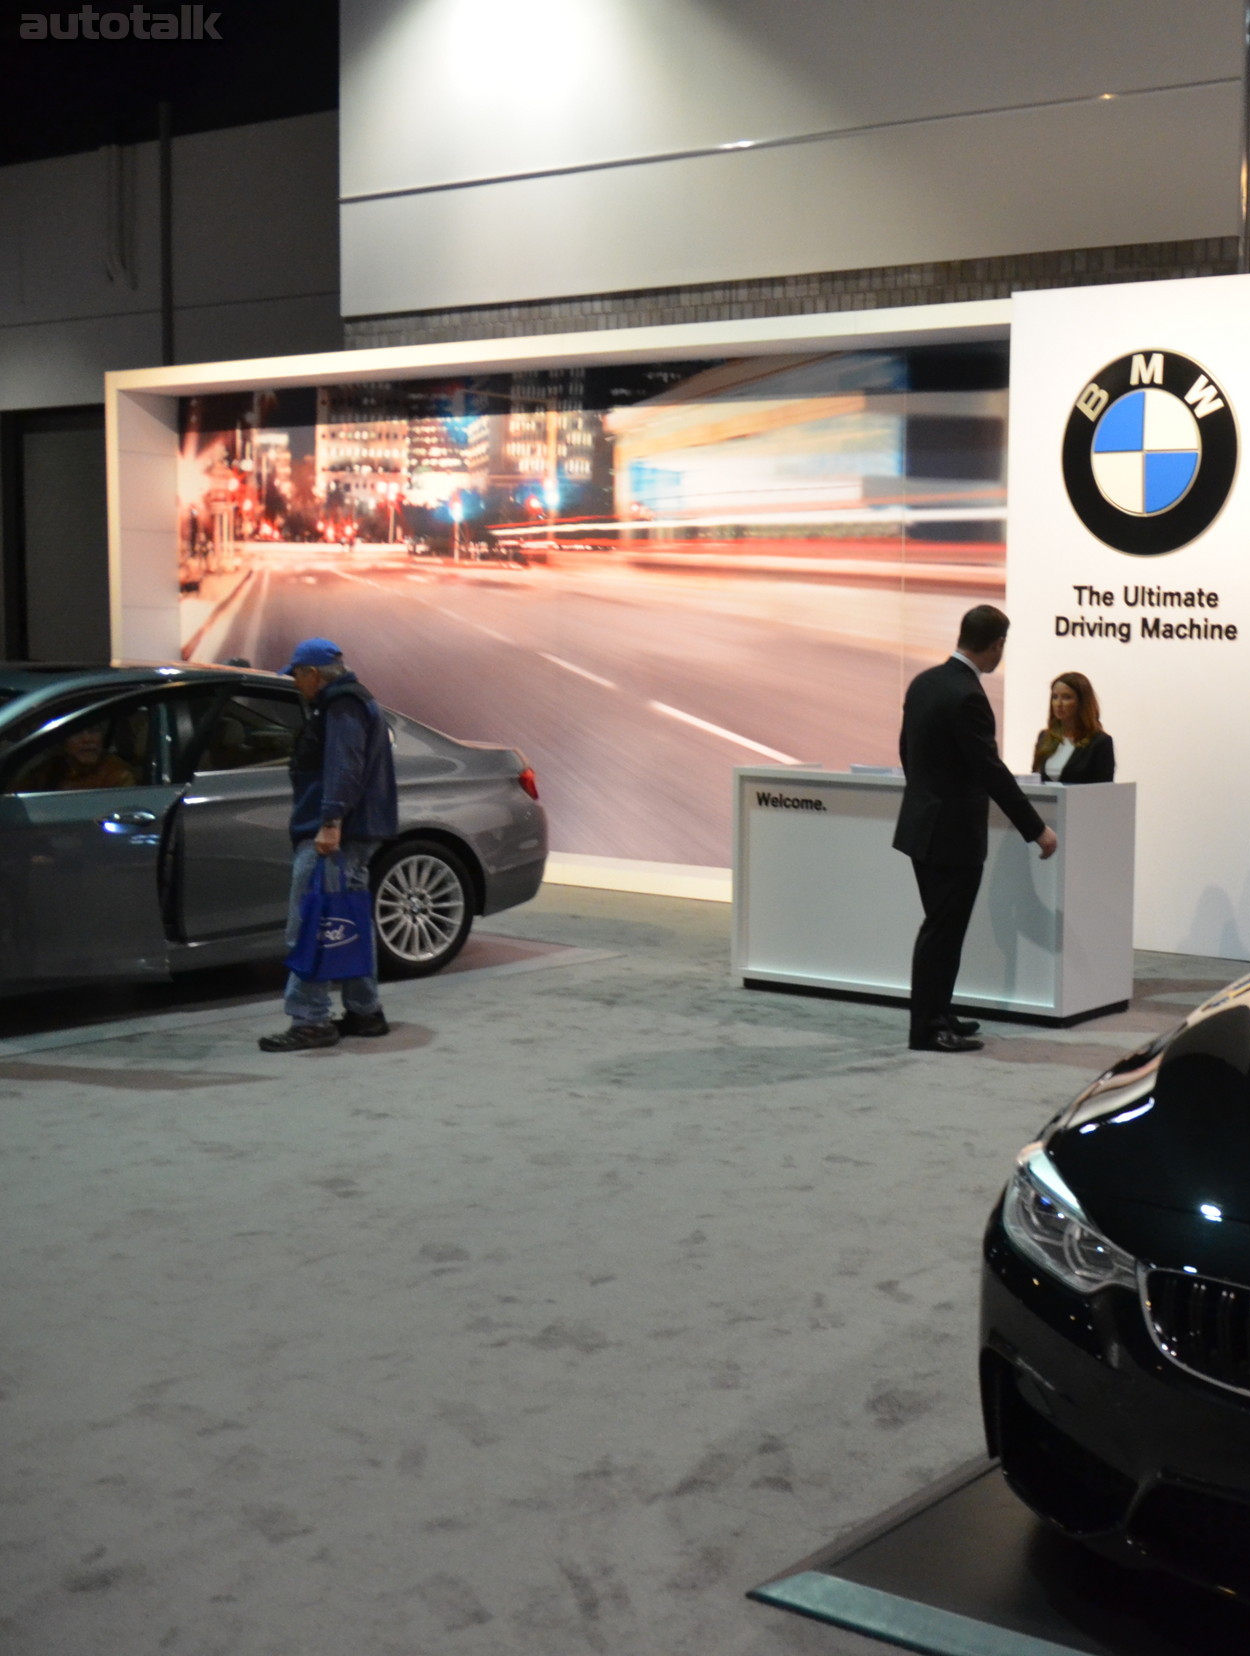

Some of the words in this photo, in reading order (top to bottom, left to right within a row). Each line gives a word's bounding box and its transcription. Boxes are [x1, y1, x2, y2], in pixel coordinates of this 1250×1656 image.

[1074, 352, 1225, 423] BMW
[1072, 585, 1115, 607] The
[1123, 585, 1220, 608] Ultimate
[1054, 615, 1132, 643] Driving
[1140, 616, 1239, 641] Machine
[756, 791, 828, 812] Welcome.
